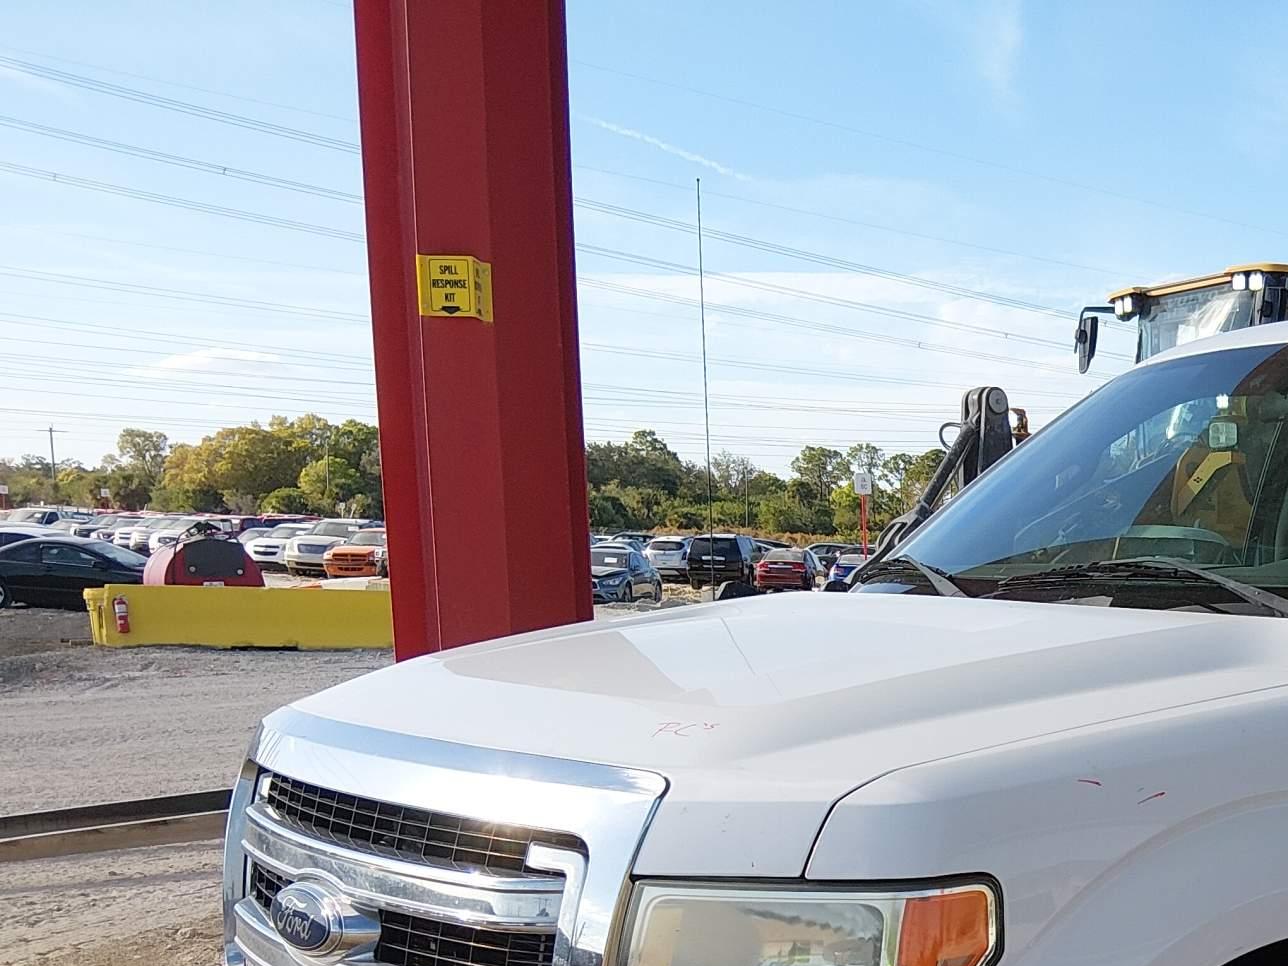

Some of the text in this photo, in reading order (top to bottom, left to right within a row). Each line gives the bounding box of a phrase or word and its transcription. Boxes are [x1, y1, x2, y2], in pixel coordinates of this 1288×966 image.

[439, 265, 459, 275] SPILL
[432, 279, 467, 289] RESPONSE
[445, 293, 456, 302] KIT
[277, 895, 312, 941] Ford
